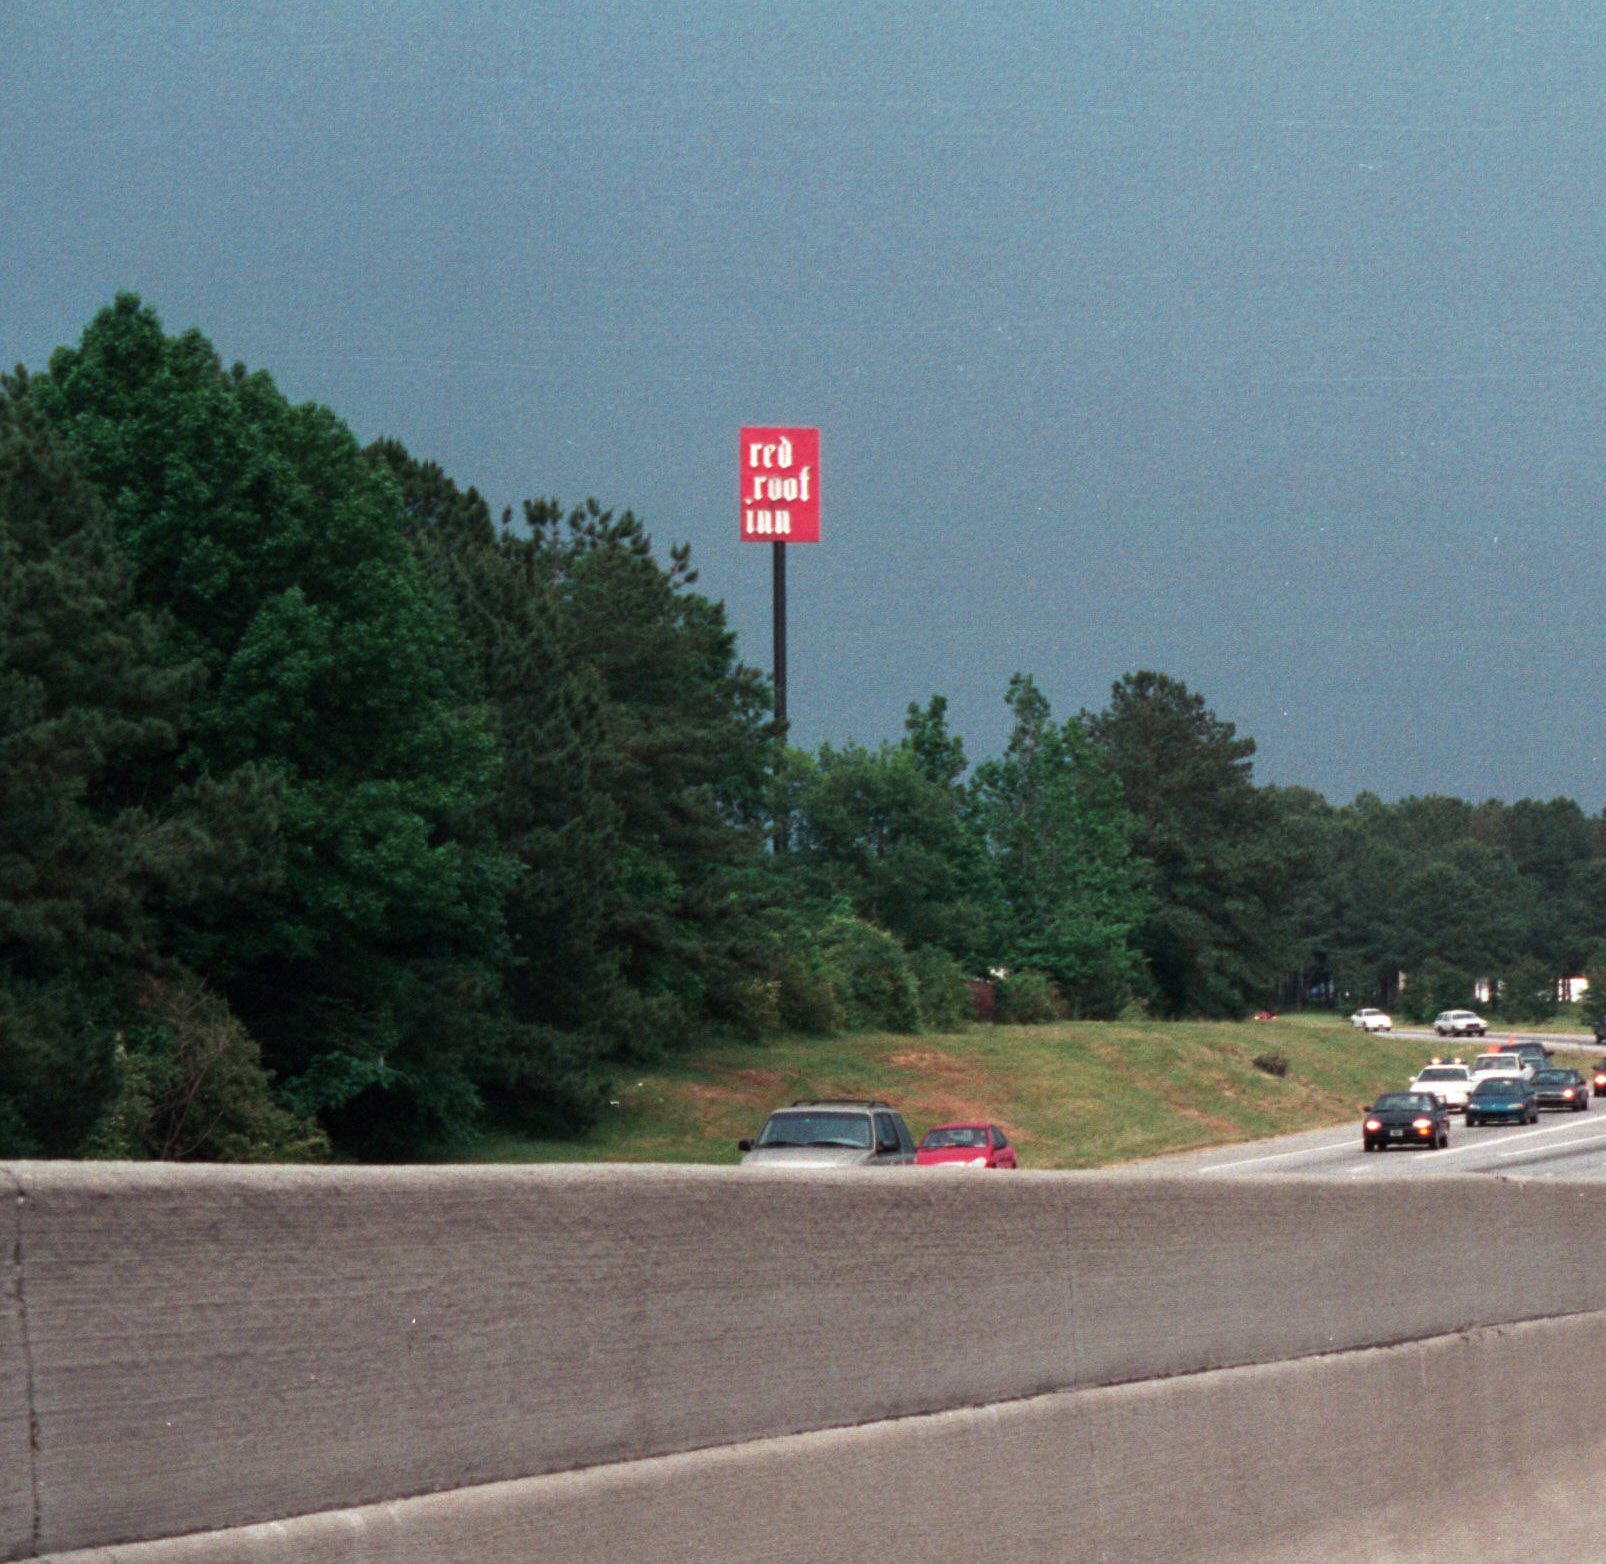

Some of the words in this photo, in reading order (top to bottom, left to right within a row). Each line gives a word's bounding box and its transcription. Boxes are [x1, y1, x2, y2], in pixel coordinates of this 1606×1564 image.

[750, 436, 792, 468] red
[753, 465, 812, 502] roof
[745, 498, 791, 534] inn
